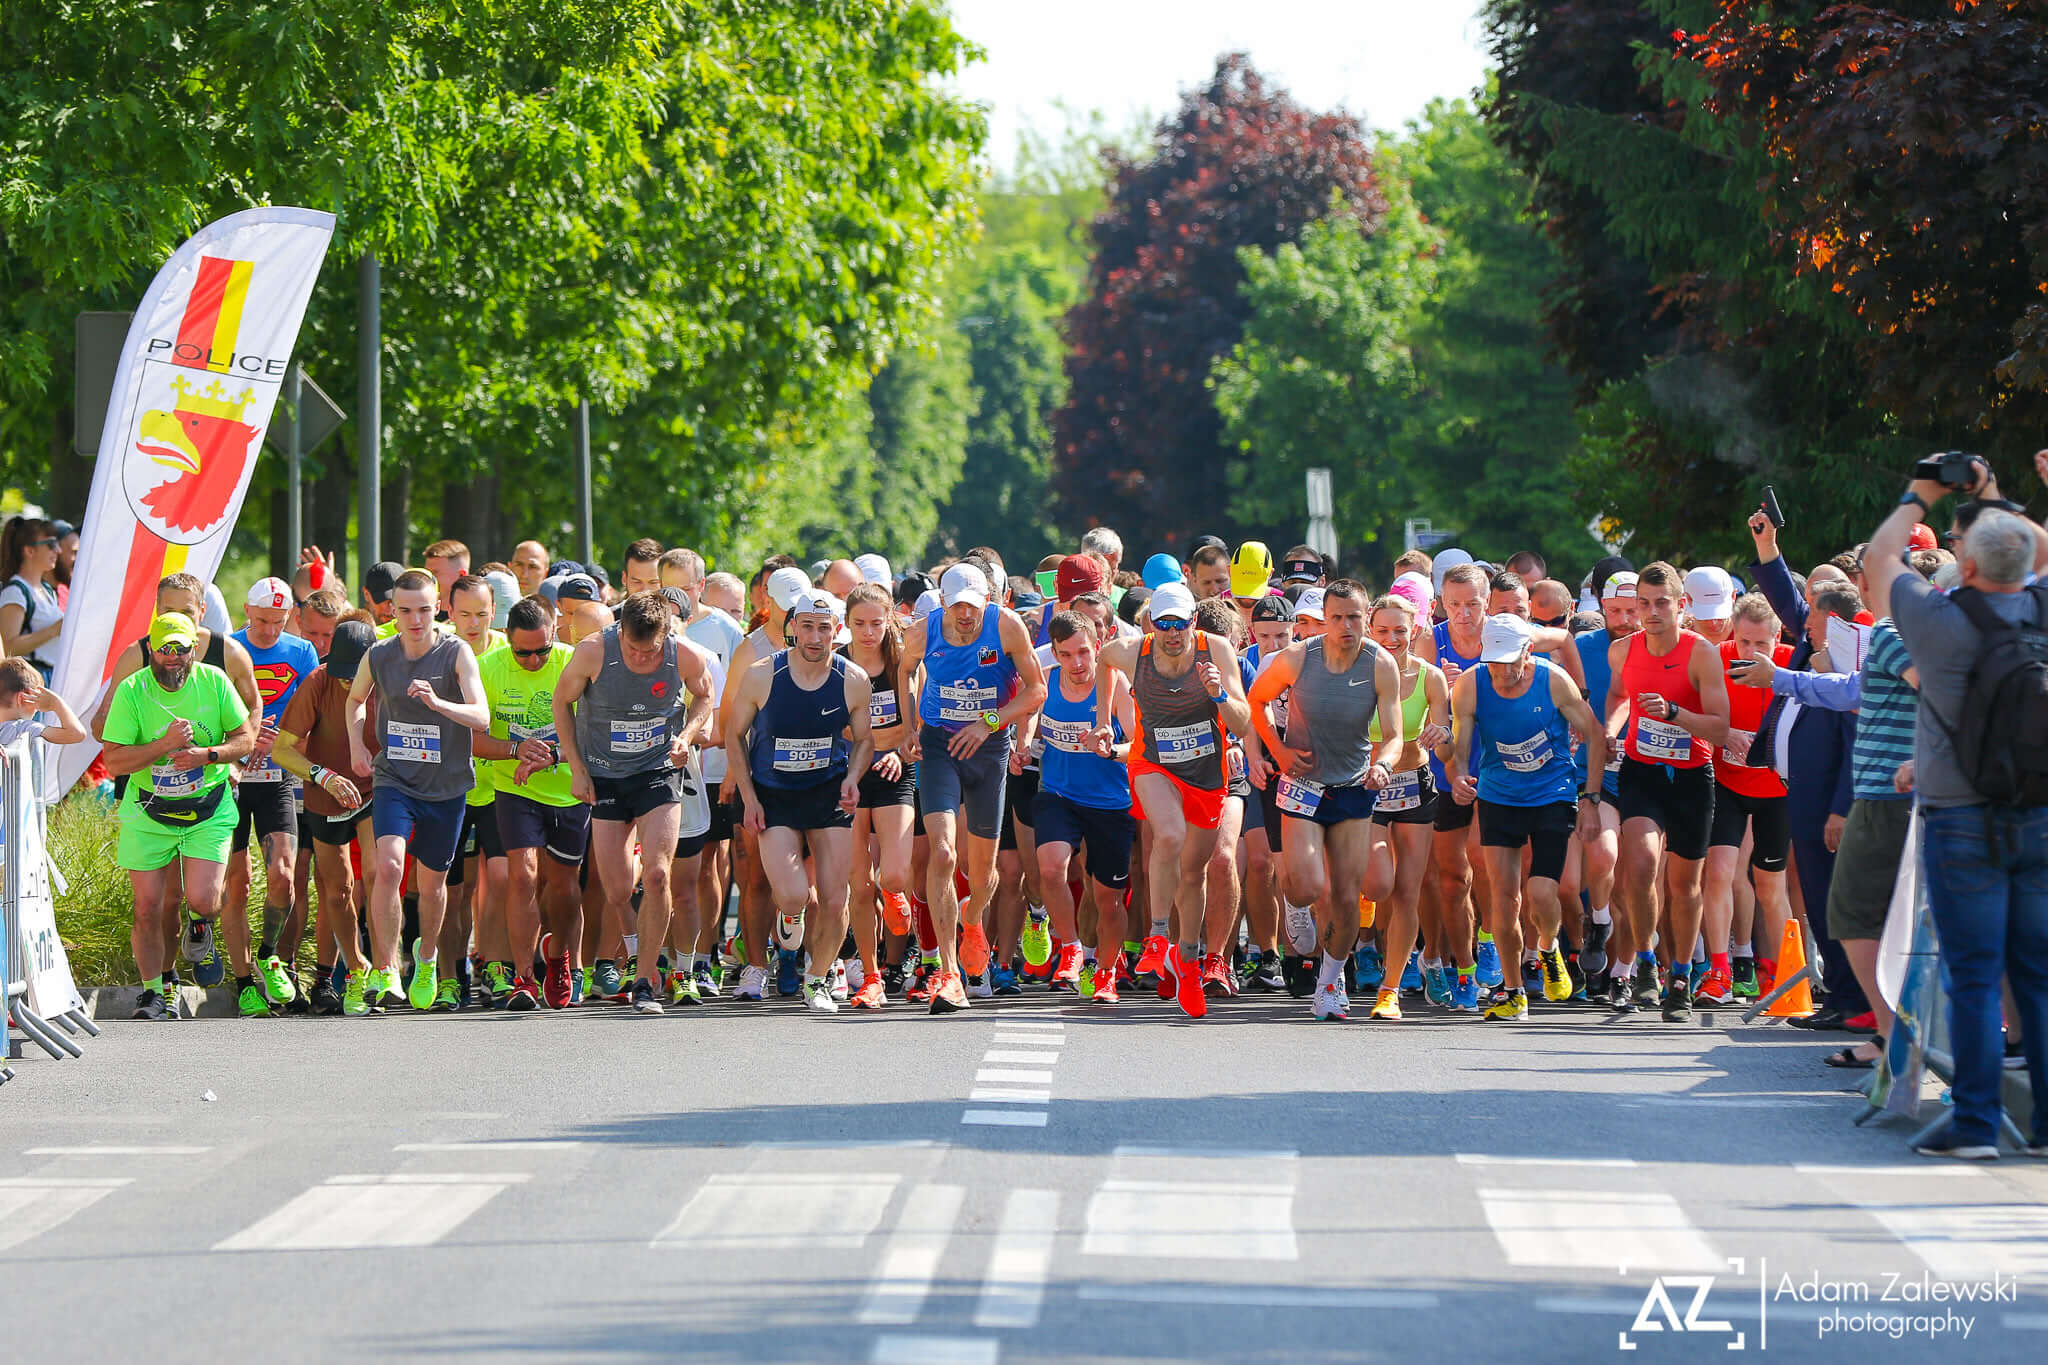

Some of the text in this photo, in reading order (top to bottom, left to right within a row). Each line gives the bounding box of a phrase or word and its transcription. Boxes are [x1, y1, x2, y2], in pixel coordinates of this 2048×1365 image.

[147, 338, 287, 375] POLICE
[955, 700, 982, 710] 201
[402, 736, 426, 749] 901
[626, 731, 652, 742] 950
[1052, 731, 1078, 742] 903
[1649, 734, 1677, 748] 997
[1172, 737, 1198, 751] 919
[789, 750, 817, 761] 905
[1517, 752, 1535, 763] 10
[169, 773, 189, 785] 46
[1283, 783, 1305, 801] 915
[1380, 787, 1406, 800] 972
